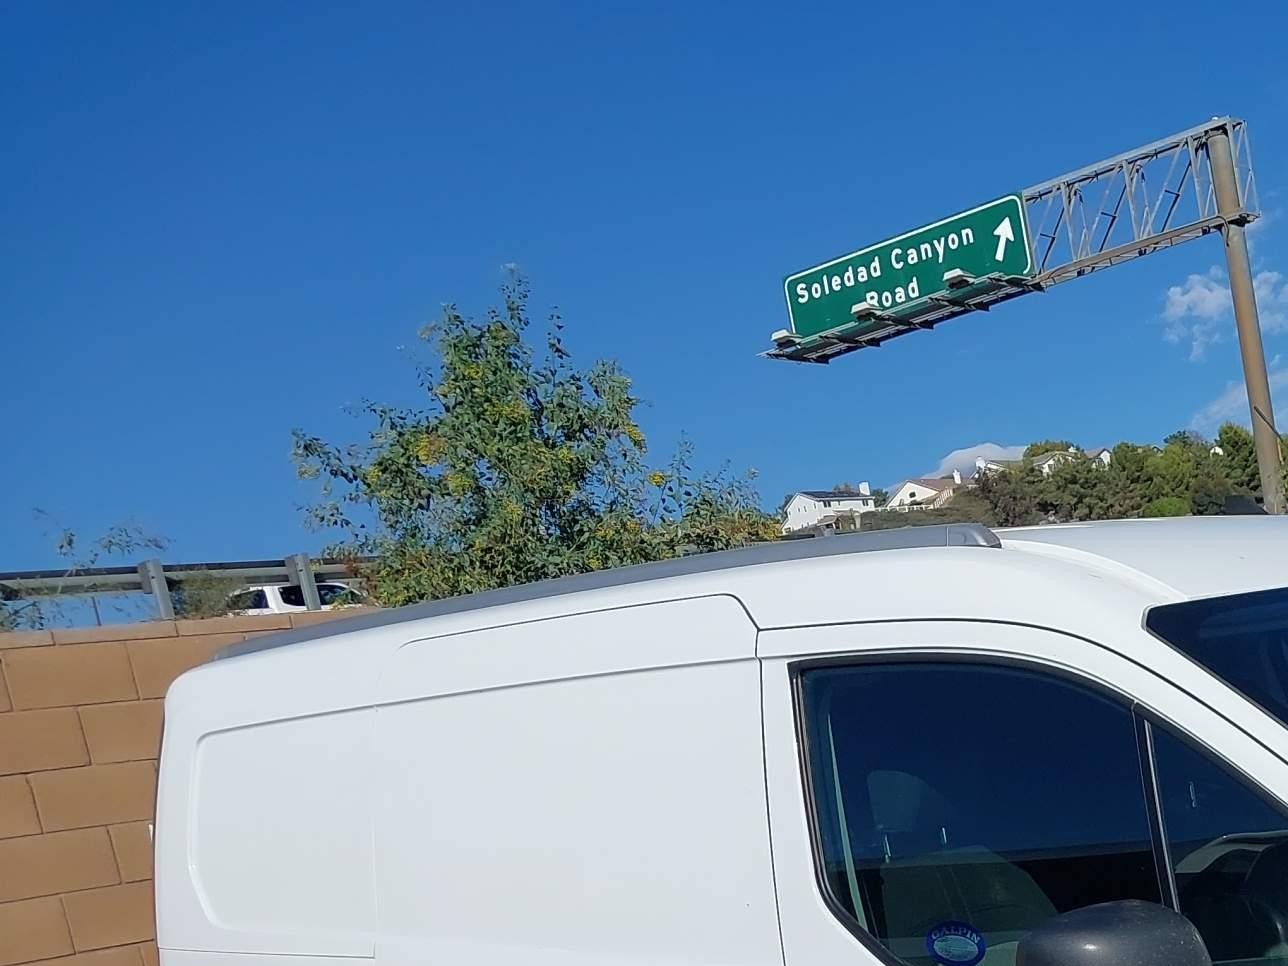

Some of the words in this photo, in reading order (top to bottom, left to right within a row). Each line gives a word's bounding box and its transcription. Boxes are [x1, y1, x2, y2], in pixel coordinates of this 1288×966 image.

[796, 256, 881, 304] Soledad
[891, 227, 975, 270] Canyon
[865, 276, 919, 308] Road
[931, 926, 981, 944] GALPIN
